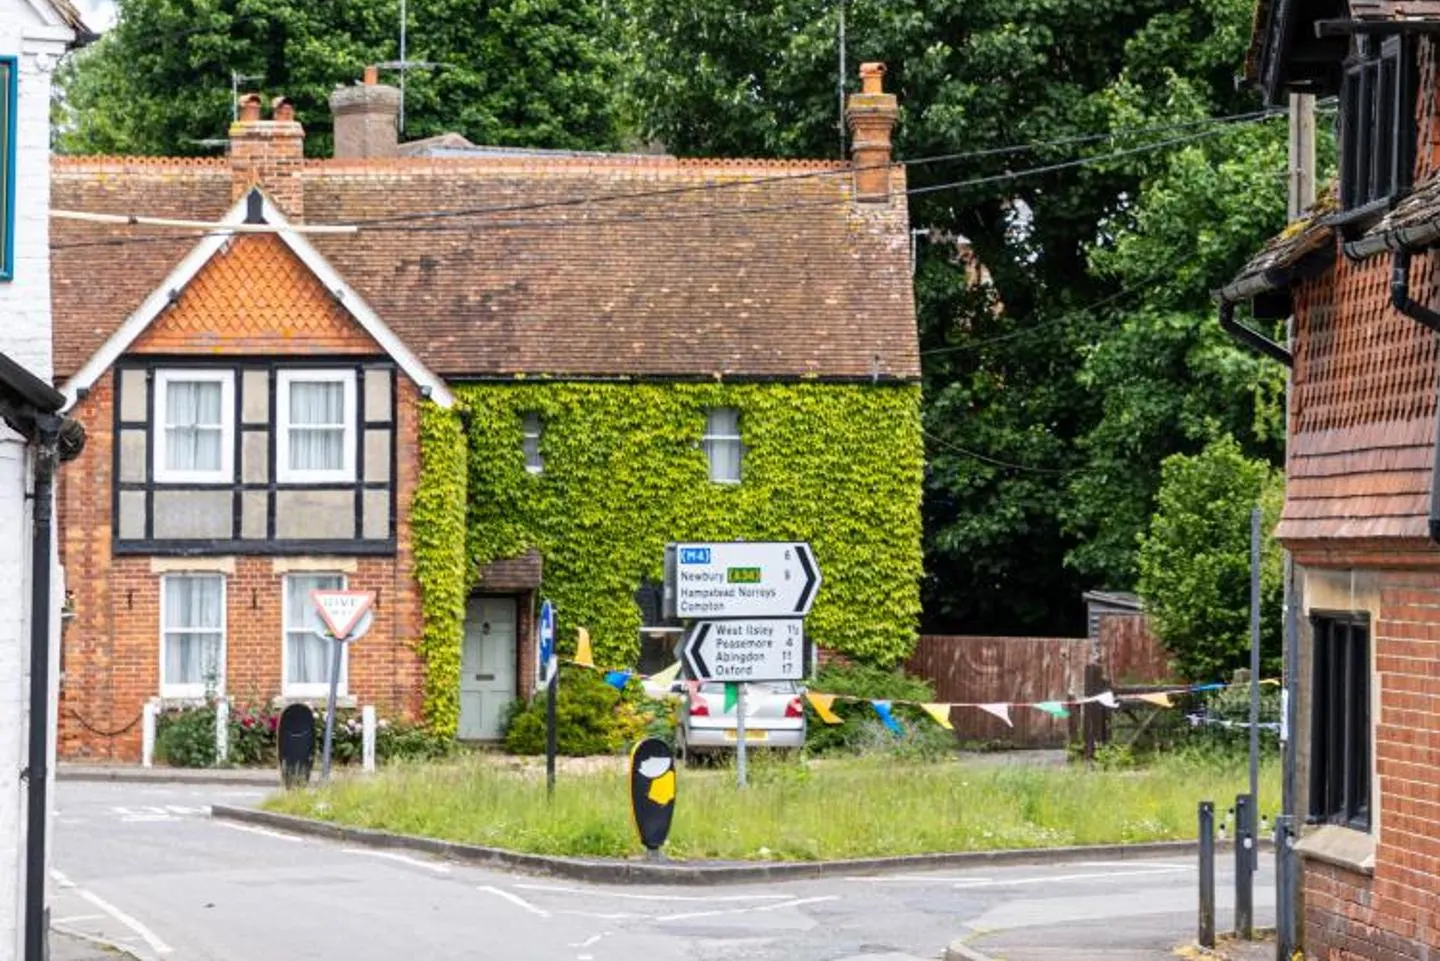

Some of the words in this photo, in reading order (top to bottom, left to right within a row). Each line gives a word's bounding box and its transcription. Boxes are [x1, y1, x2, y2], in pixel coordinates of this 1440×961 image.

[681, 571, 723, 583] Newbury
[681, 587, 735, 599] Hampstead
[739, 587, 776, 599] Norreys
[681, 601, 724, 612] Compton
[716, 625, 742, 636] West
[746, 625, 773, 637] Ilsley
[716, 639, 772, 649] Peasemore
[716, 651, 765, 664] Abingdon
[716, 664, 752, 675] Oxford
[782, 663, 792, 673] 17
